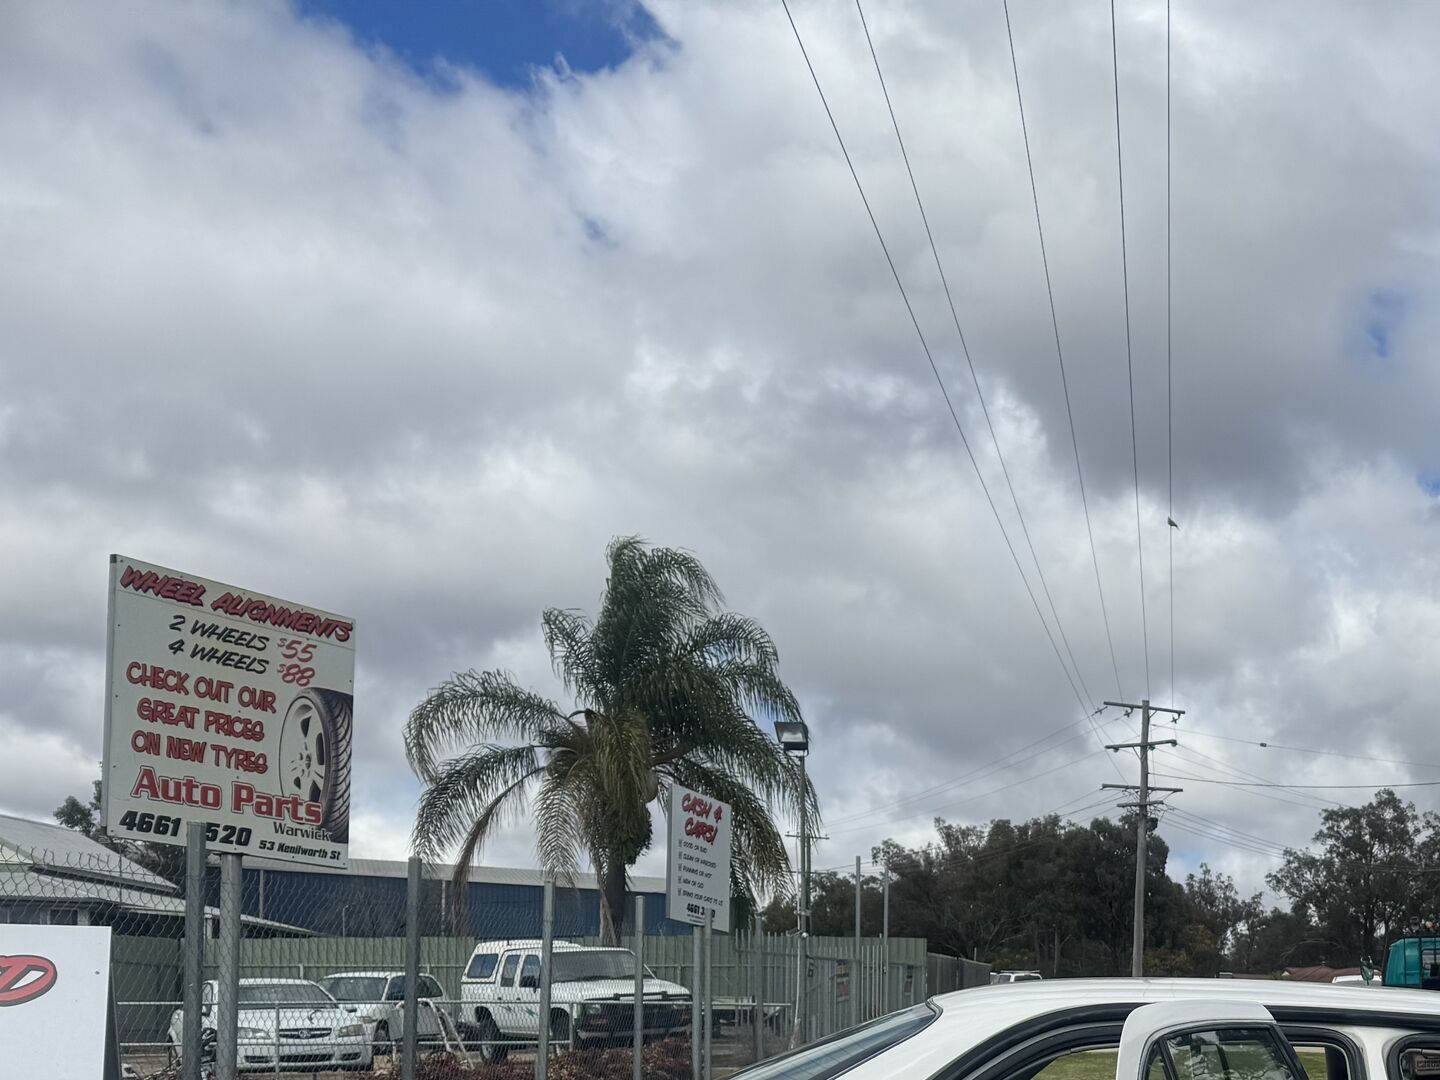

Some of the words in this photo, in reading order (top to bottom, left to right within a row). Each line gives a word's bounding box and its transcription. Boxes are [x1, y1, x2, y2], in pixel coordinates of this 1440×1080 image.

[119, 565, 207, 607] WHEEL
[211, 592, 353, 642] ALIGNMENTS
[169, 614, 186, 632] 2
[190, 620, 270, 651] WHEELS
[277, 637, 317, 663] $55
[168, 639, 186, 656] 4
[190, 643, 270, 675] WHEELS
[276, 663, 316, 687] $88
[125, 661, 190, 696] CHECK
[193, 676, 234, 703] OUT
[238, 685, 277, 713] OUR
[136, 697, 200, 730] GREAT
[203, 710, 265, 742] PRICES
[131, 730, 161, 756] ON
[165, 736, 206, 763] NEW
[211, 743, 268, 774] TYRES
[130, 766, 222, 809] Auto
[231, 780, 323, 826] Parts
[681, 793, 713, 820] CASH
[119, 810, 182, 837] 4661
[204, 821, 253, 846] 520
[258, 839, 275, 851] 53
[277, 842, 328, 859] Kenilworth
[329, 850, 341, 861] St
[273, 821, 333, 842] Warwick
